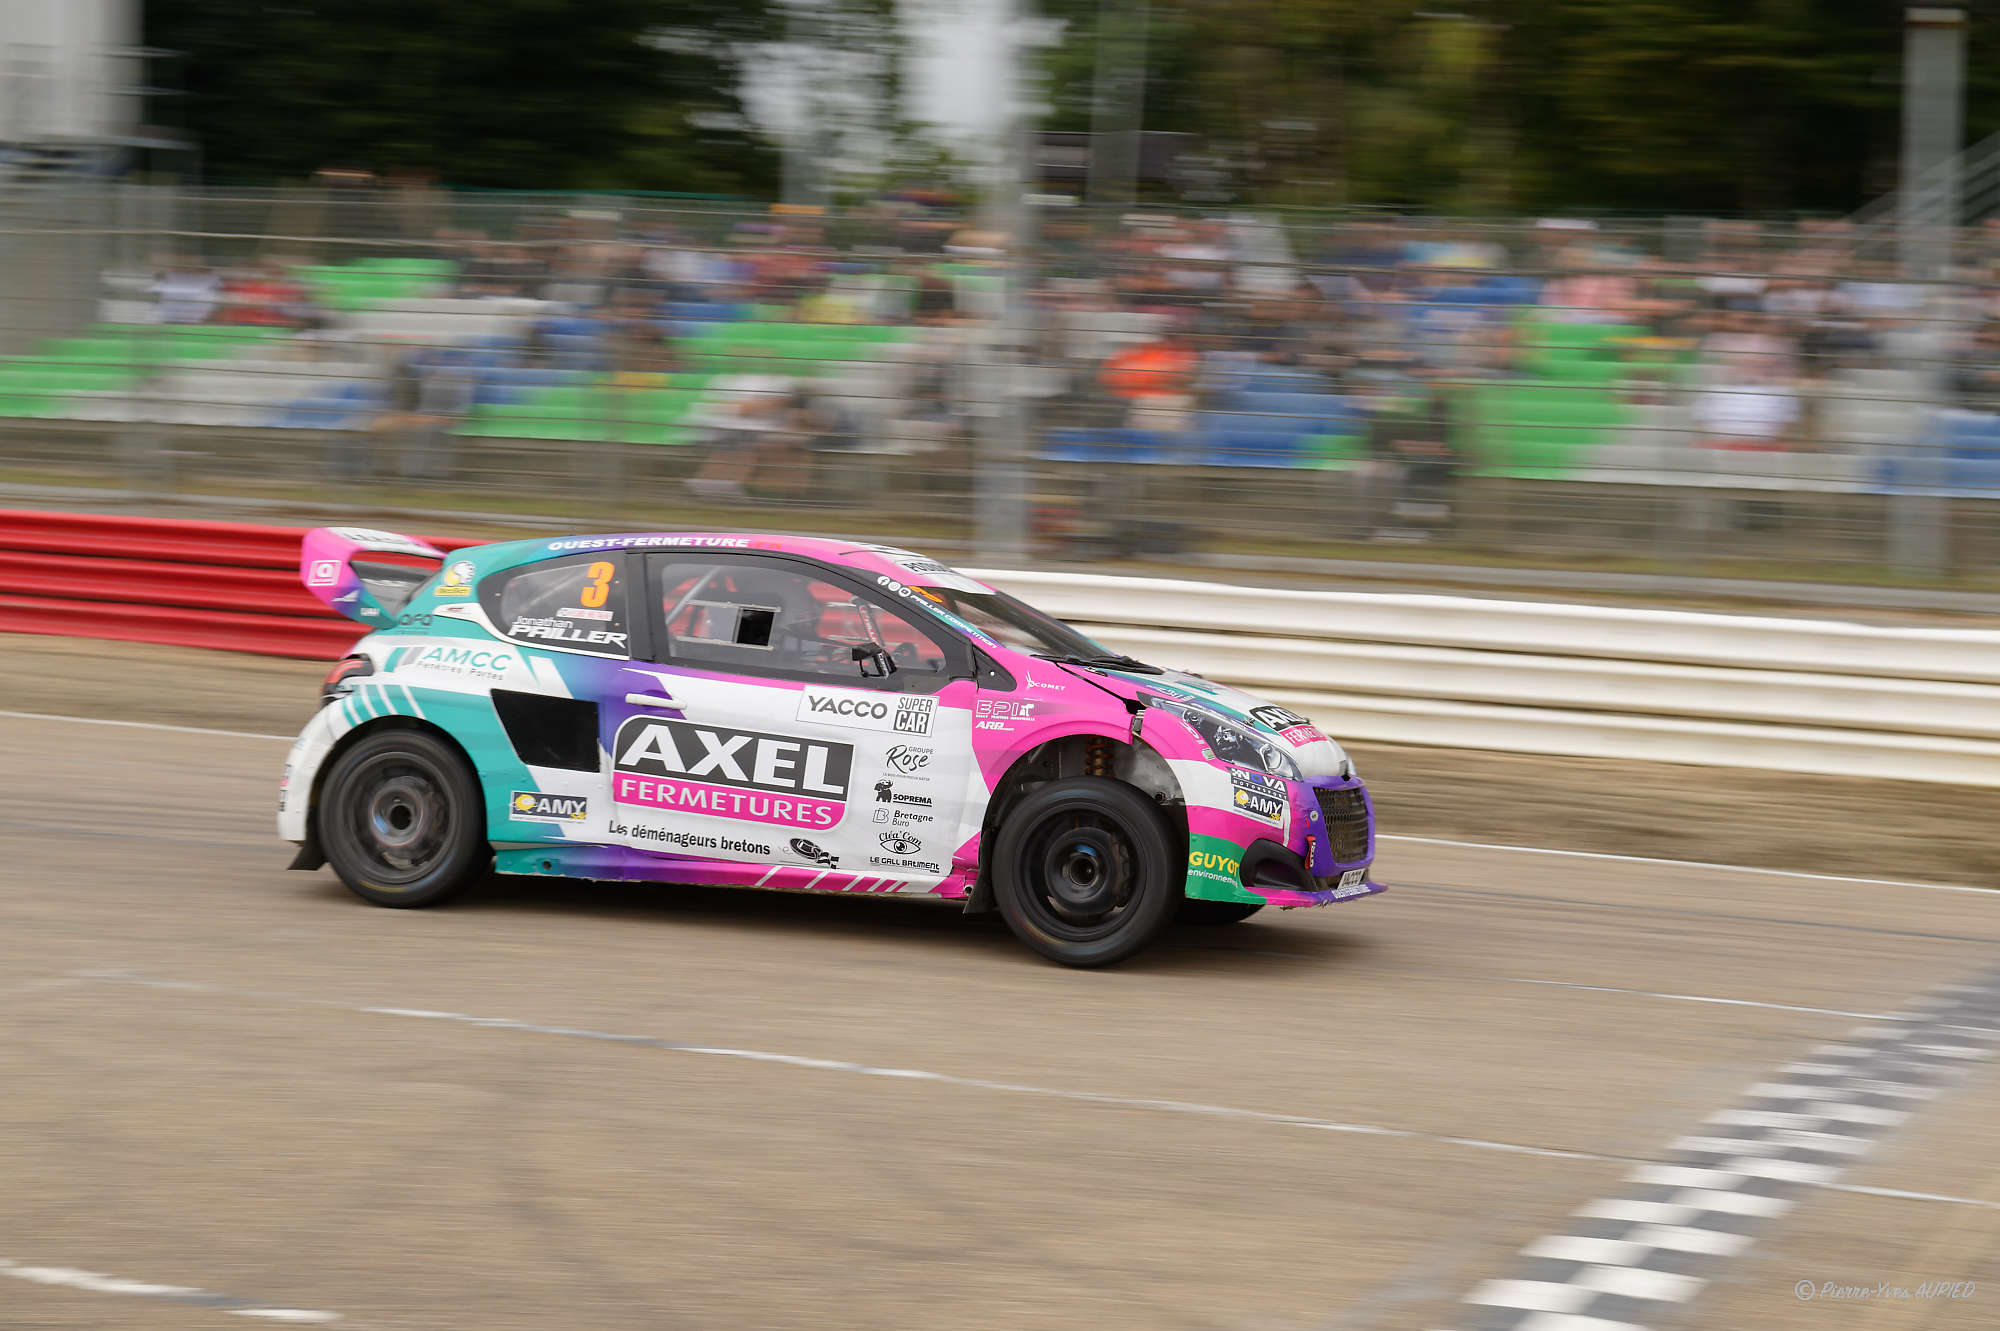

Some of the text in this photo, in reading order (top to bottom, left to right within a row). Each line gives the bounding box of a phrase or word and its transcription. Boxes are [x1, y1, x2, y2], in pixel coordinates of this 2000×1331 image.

[580, 561, 615, 608] 3
[514, 615, 574, 629] Jonathan
[506, 625, 629, 649] PAILLER
[423, 647, 512, 671] AMCC
[1034, 682, 1066, 691] COMET
[808, 695, 888, 720] YACCO
[897, 696, 933, 713] SUPER
[895, 711, 928, 733] CAR
[617, 723, 845, 795] AXEL
[885, 744, 930, 774] Rose
[908, 746, 934, 755] GROUPE
[892, 793, 933, 805] SOPREMA
[1233, 779, 1287, 801] MOTORSPORT
[536, 797, 586, 815] AMY
[620, 778, 834, 826] FERMETURES
[1250, 795, 1282, 816] AMY
[892, 818, 910, 827] Buro
[894, 810, 934, 823] Bretagne
[608, 820, 771, 855] Les déménageurs bretons
[869, 856, 880, 864] LE
[881, 857, 900, 866] GALL
[1188, 851, 1239, 878] GUYOT
[1187, 868, 1238, 889] environnem
